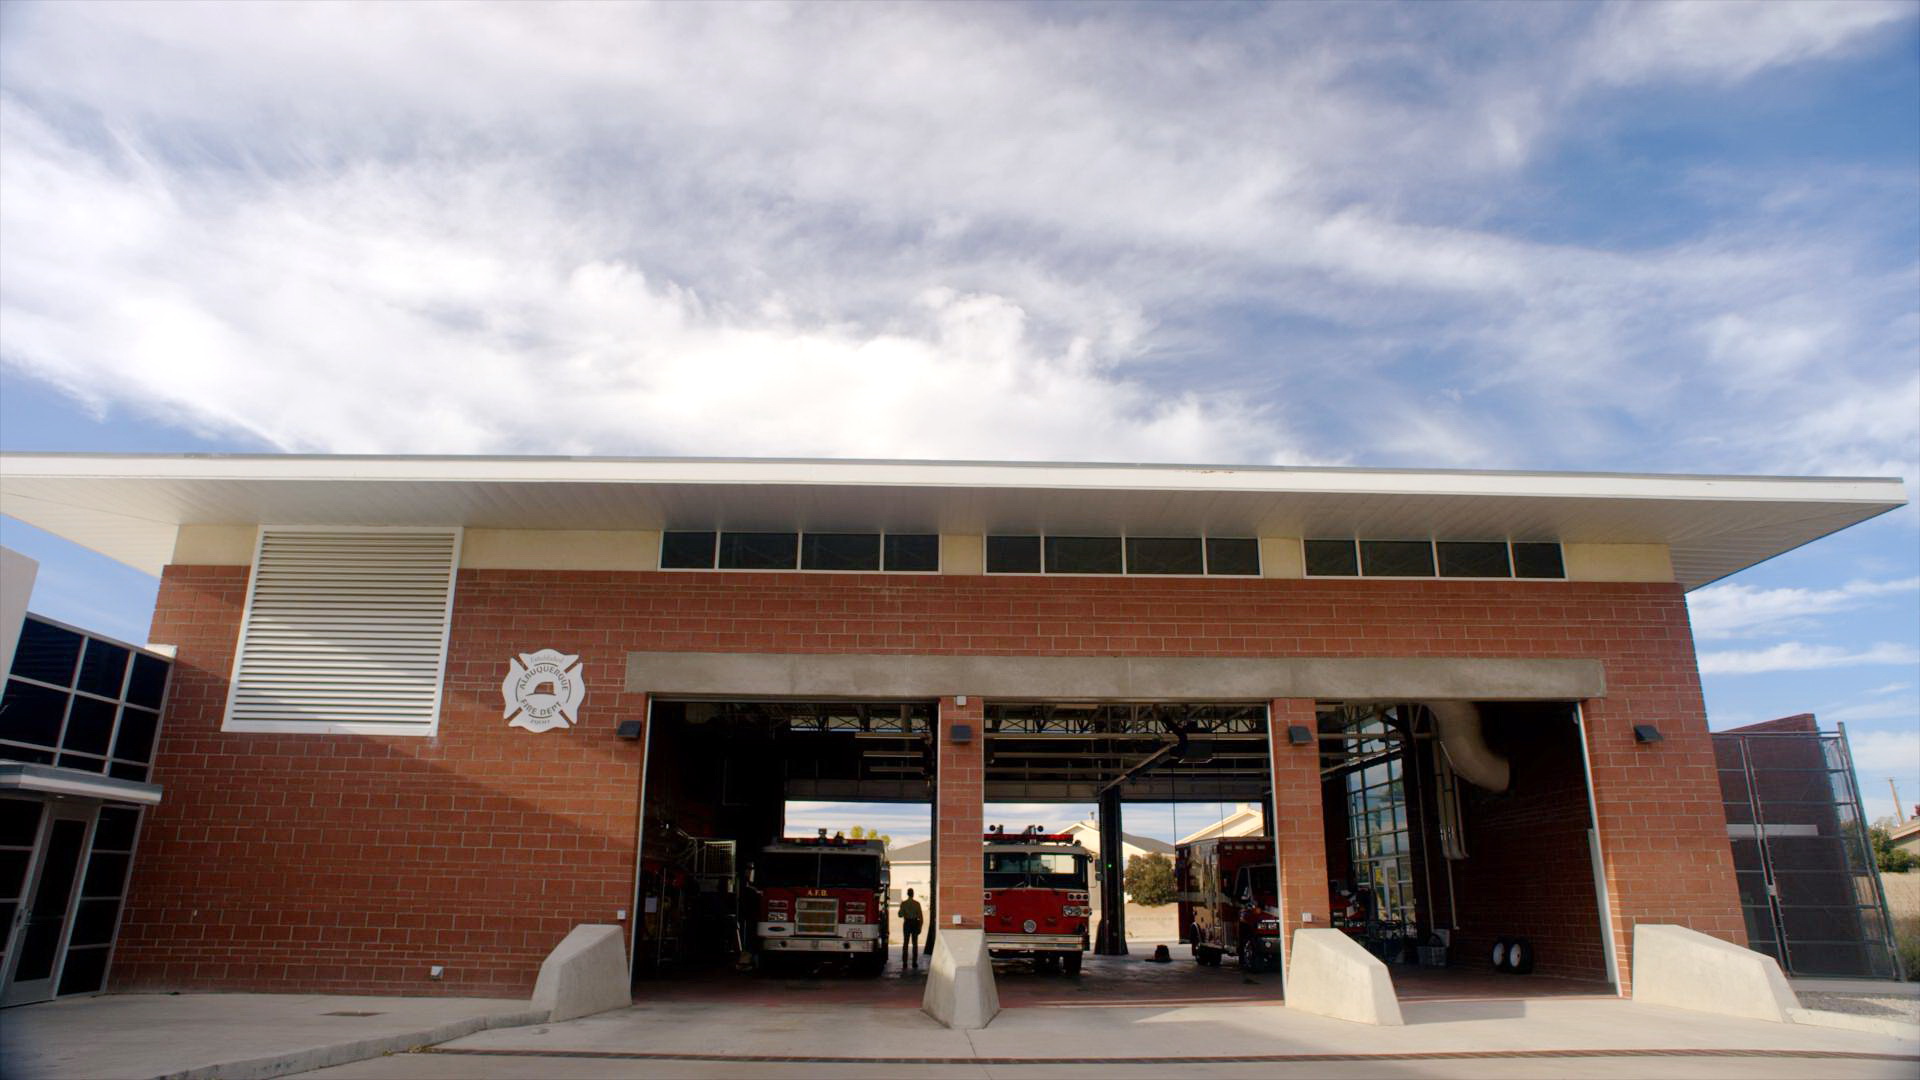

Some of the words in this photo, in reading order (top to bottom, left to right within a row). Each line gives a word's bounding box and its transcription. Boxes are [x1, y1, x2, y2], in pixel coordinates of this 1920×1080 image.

[519, 666, 569, 691] ALBUQUERQUE
[520, 698, 538, 715] FIRE
[539, 701, 562, 716] DEPT
